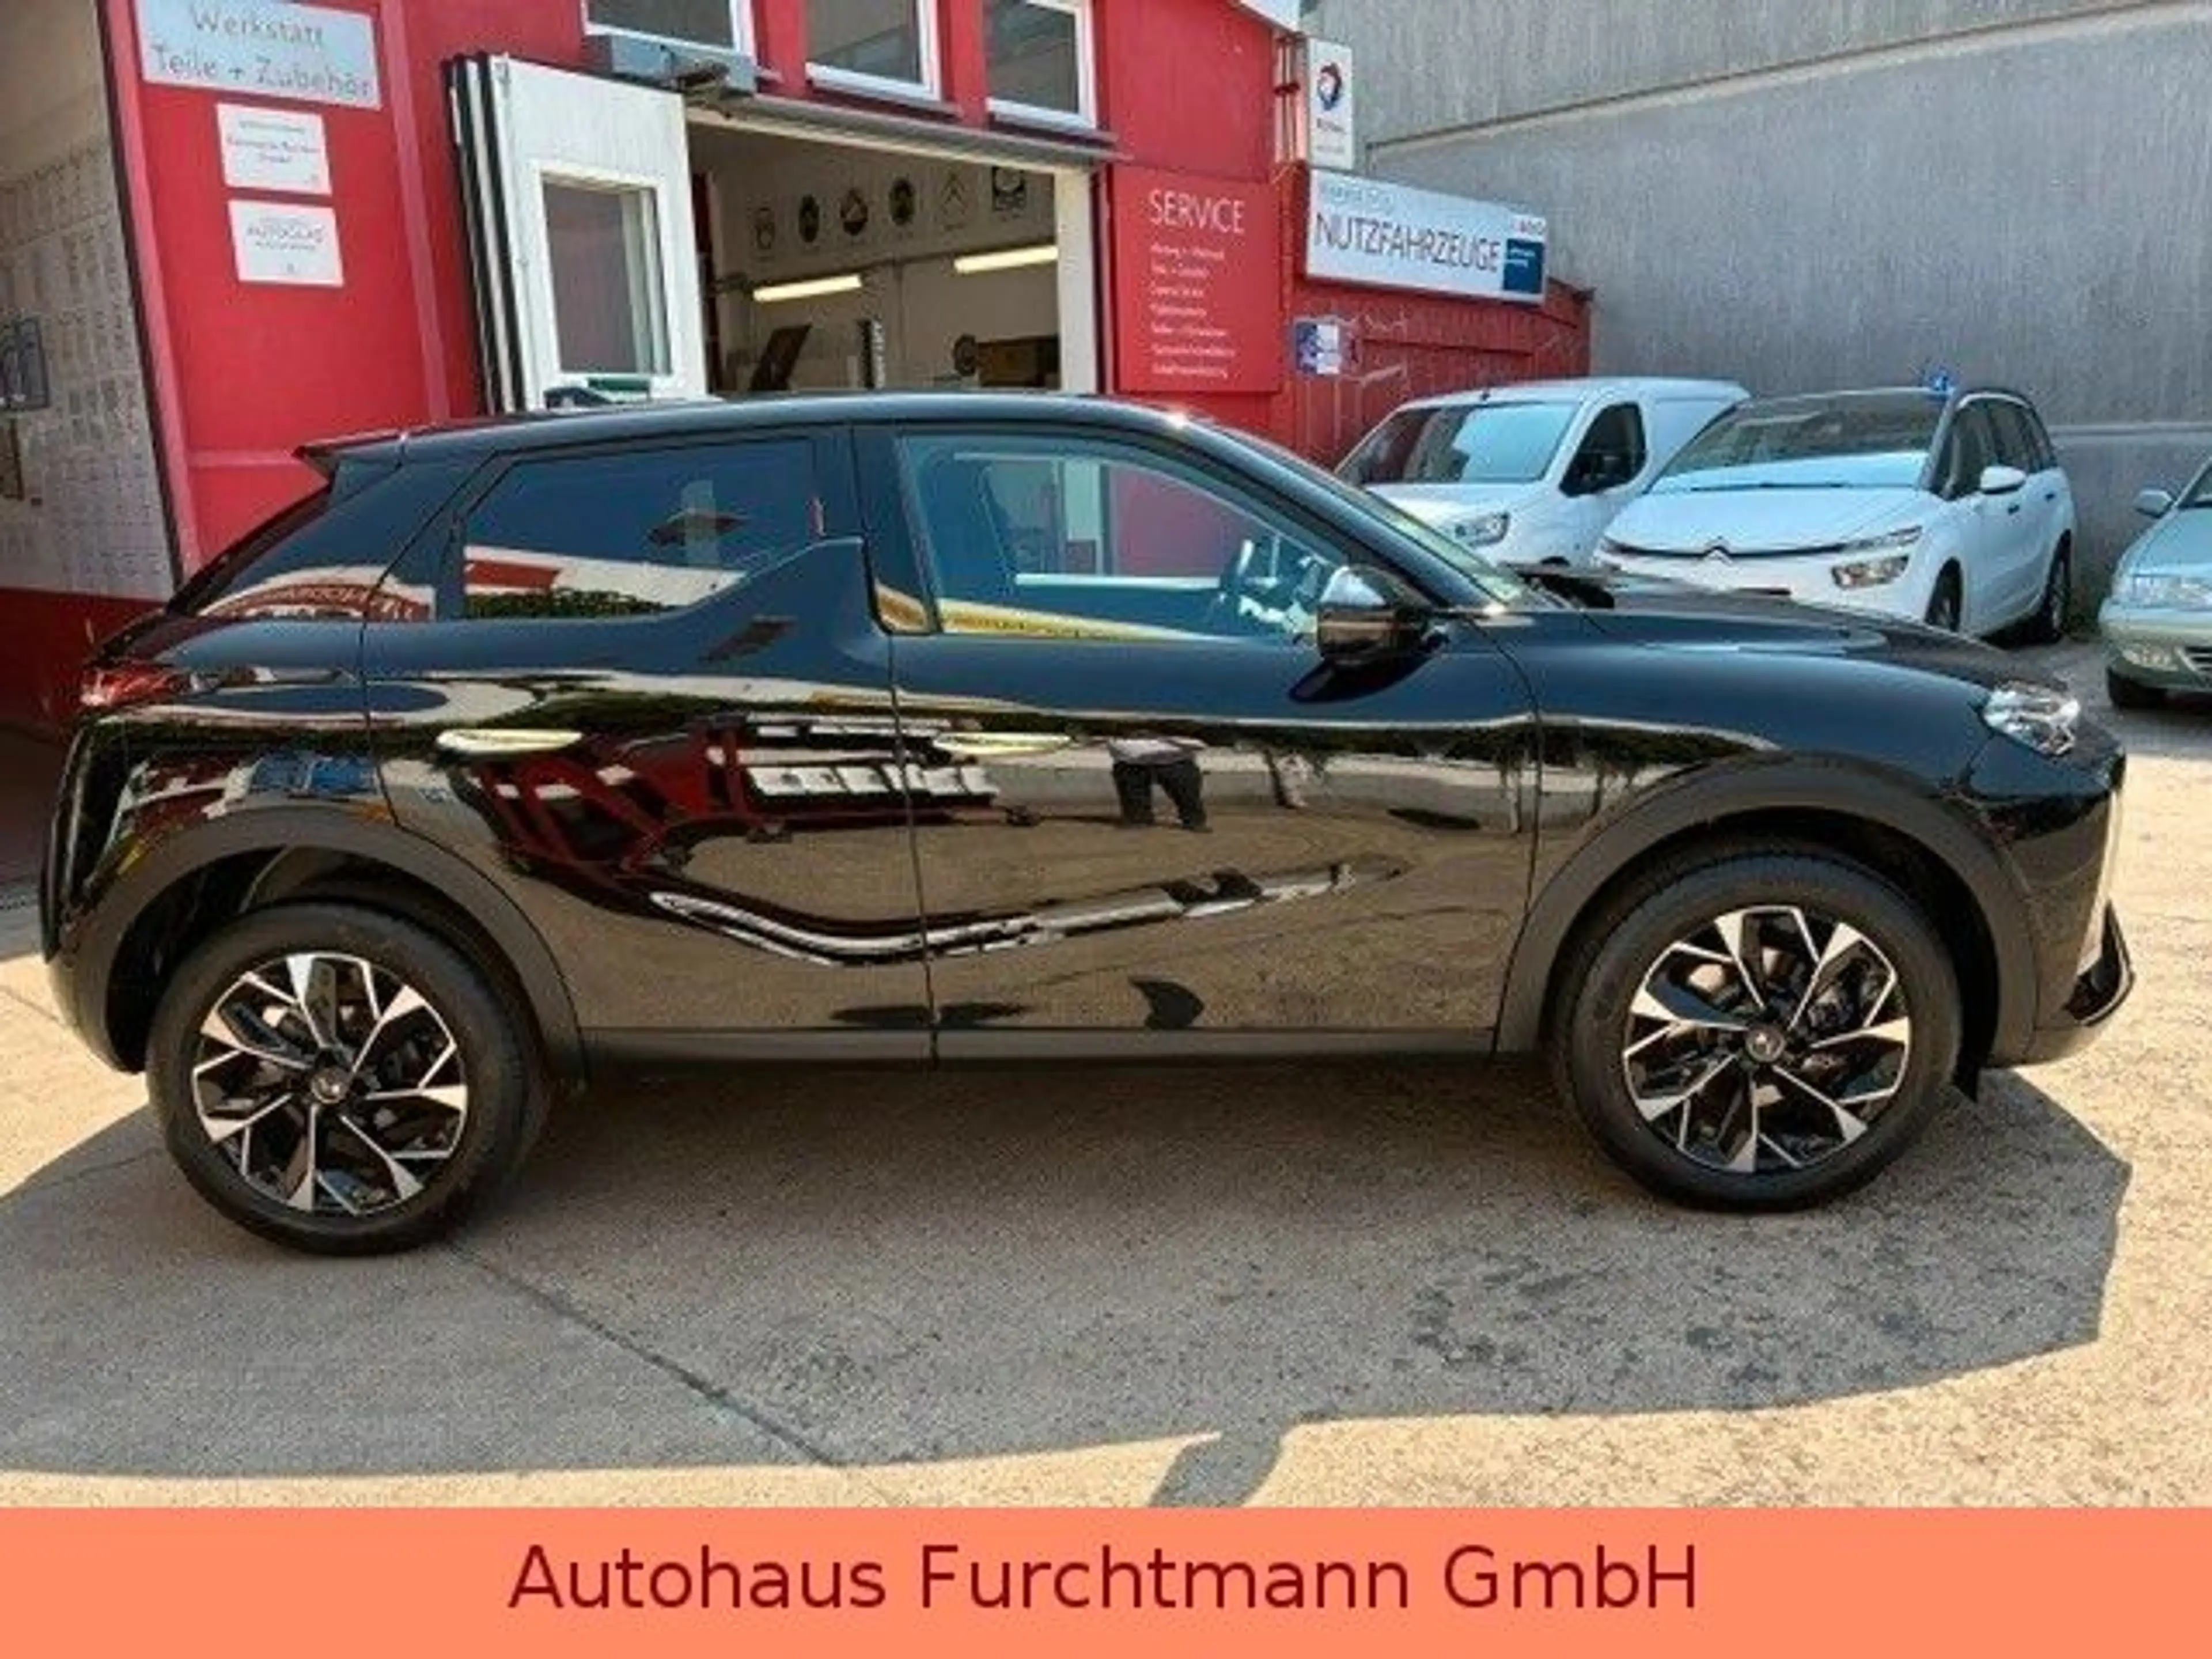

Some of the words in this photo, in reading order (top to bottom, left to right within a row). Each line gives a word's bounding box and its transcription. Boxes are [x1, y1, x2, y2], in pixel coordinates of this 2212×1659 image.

[189, 2, 324, 45] Werkstatt
[151, 44, 216, 78] Teile
[228, 65, 243, 81] +
[256, 56, 371, 97] Zubehör
[1150, 190, 1245, 233] SERVICE
[1314, 214, 1501, 272] NUTZFAHRZEUGE
